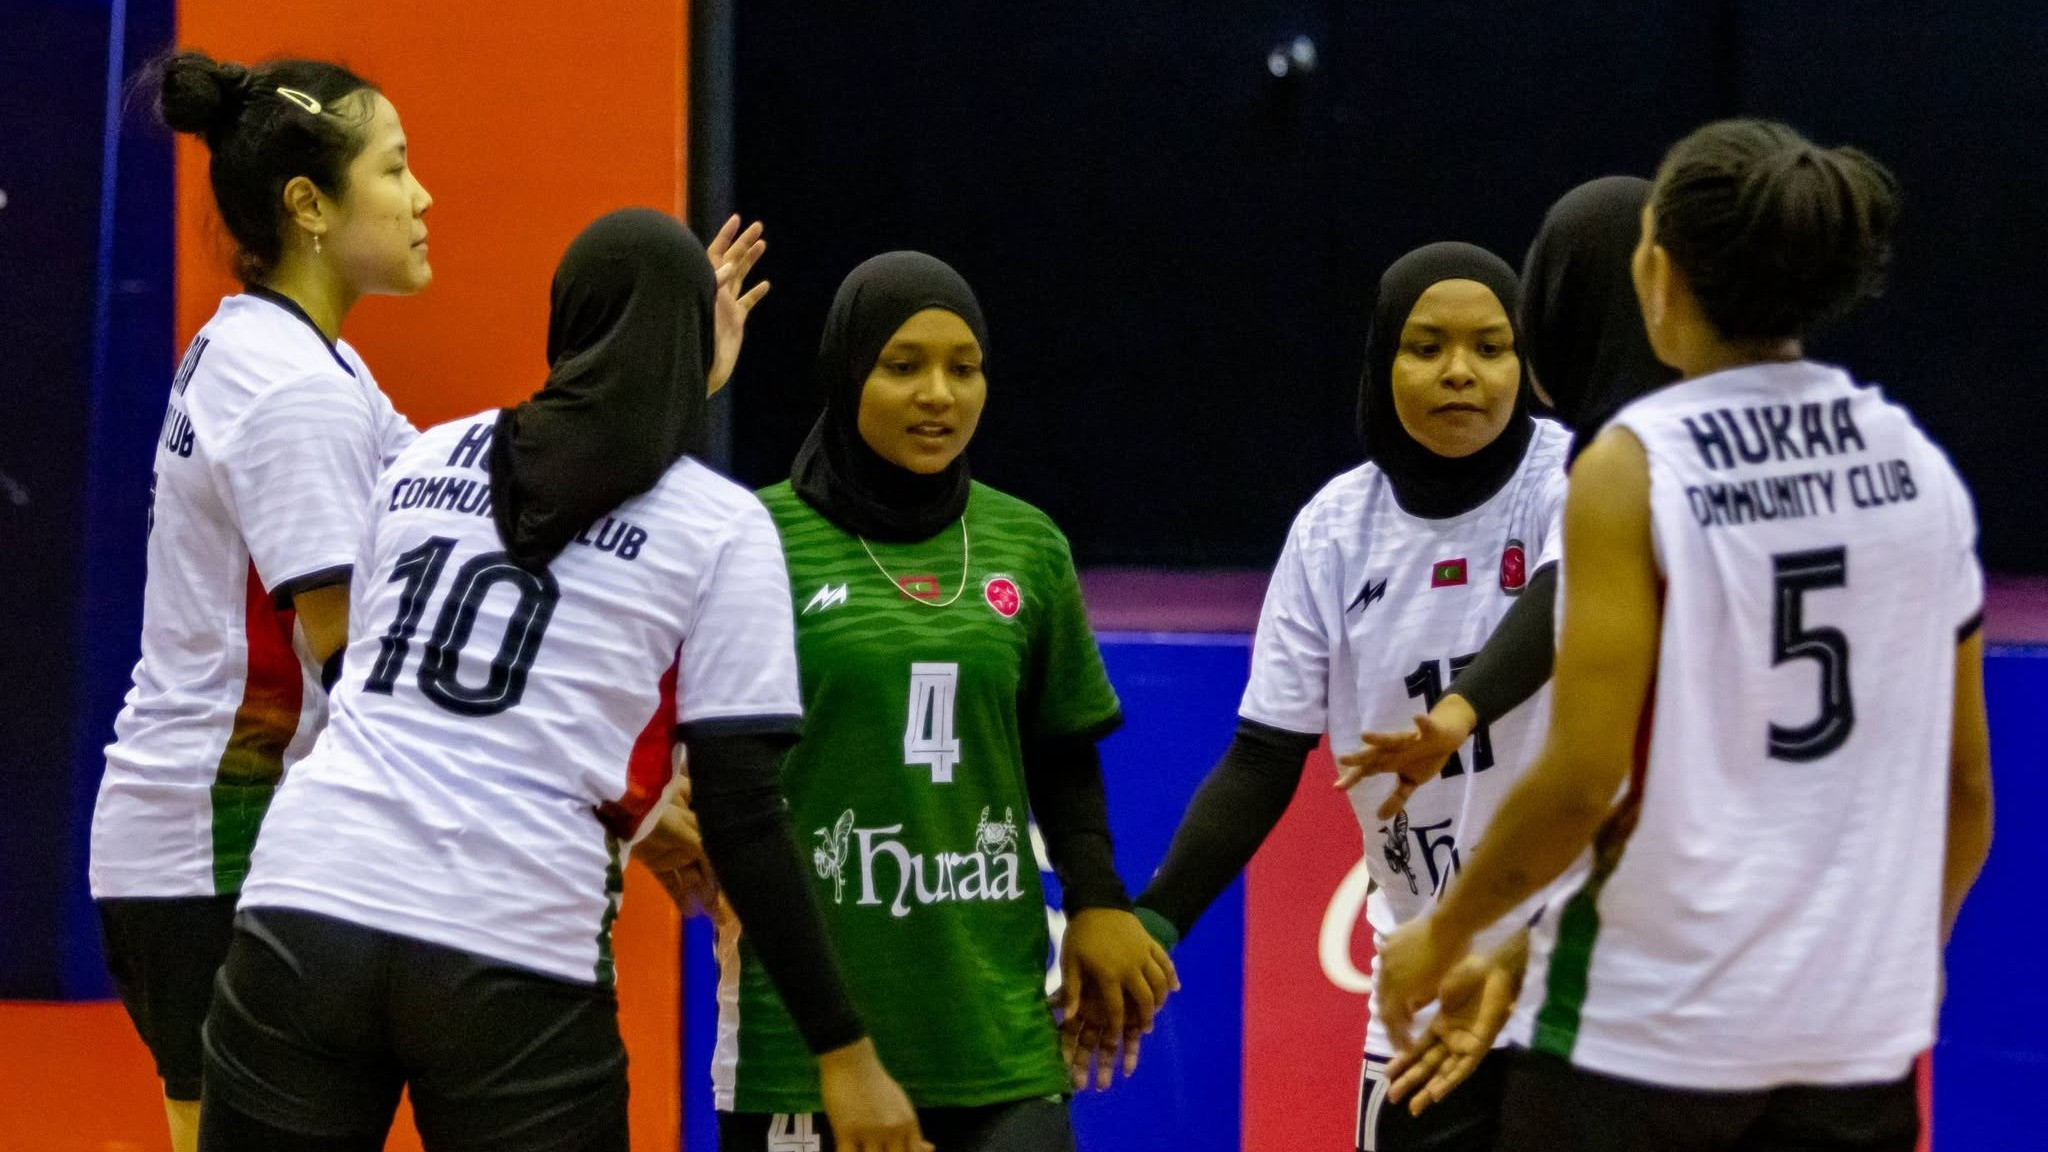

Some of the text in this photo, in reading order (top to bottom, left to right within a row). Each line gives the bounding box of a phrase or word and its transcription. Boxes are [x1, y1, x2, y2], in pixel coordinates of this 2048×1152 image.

[576, 517, 648, 560] LUB
[1686, 459, 1918, 527] OMMUNITY CLUB
[362, 535, 560, 717] 10
[1766, 545, 1855, 763] 5
[904, 662, 960, 783] 4
[768, 1113, 820, 1152] 4
